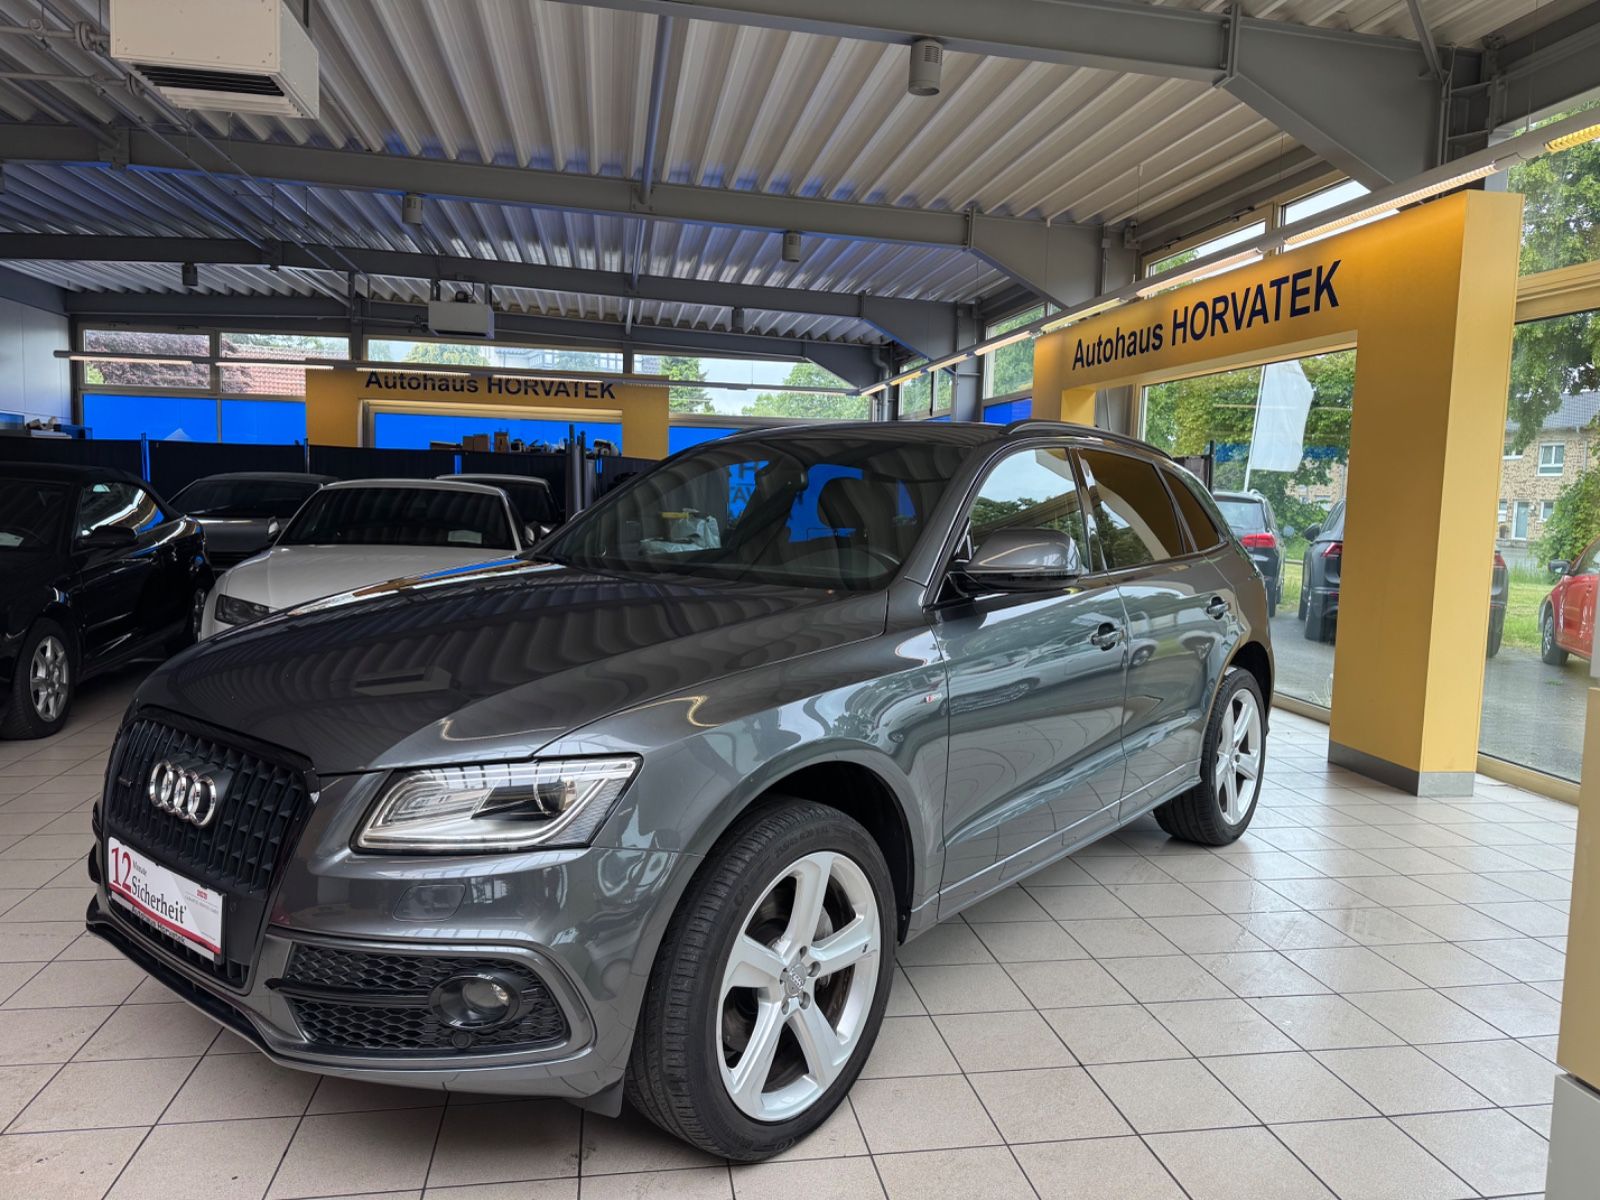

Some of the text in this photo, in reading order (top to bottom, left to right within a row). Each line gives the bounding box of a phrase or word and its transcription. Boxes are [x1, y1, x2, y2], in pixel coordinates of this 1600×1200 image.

[1072, 260, 1342, 371] Autohaus HORVATEK
[365, 371, 616, 400] Autohaus HORVATEK
[111, 847, 131, 894] 12
